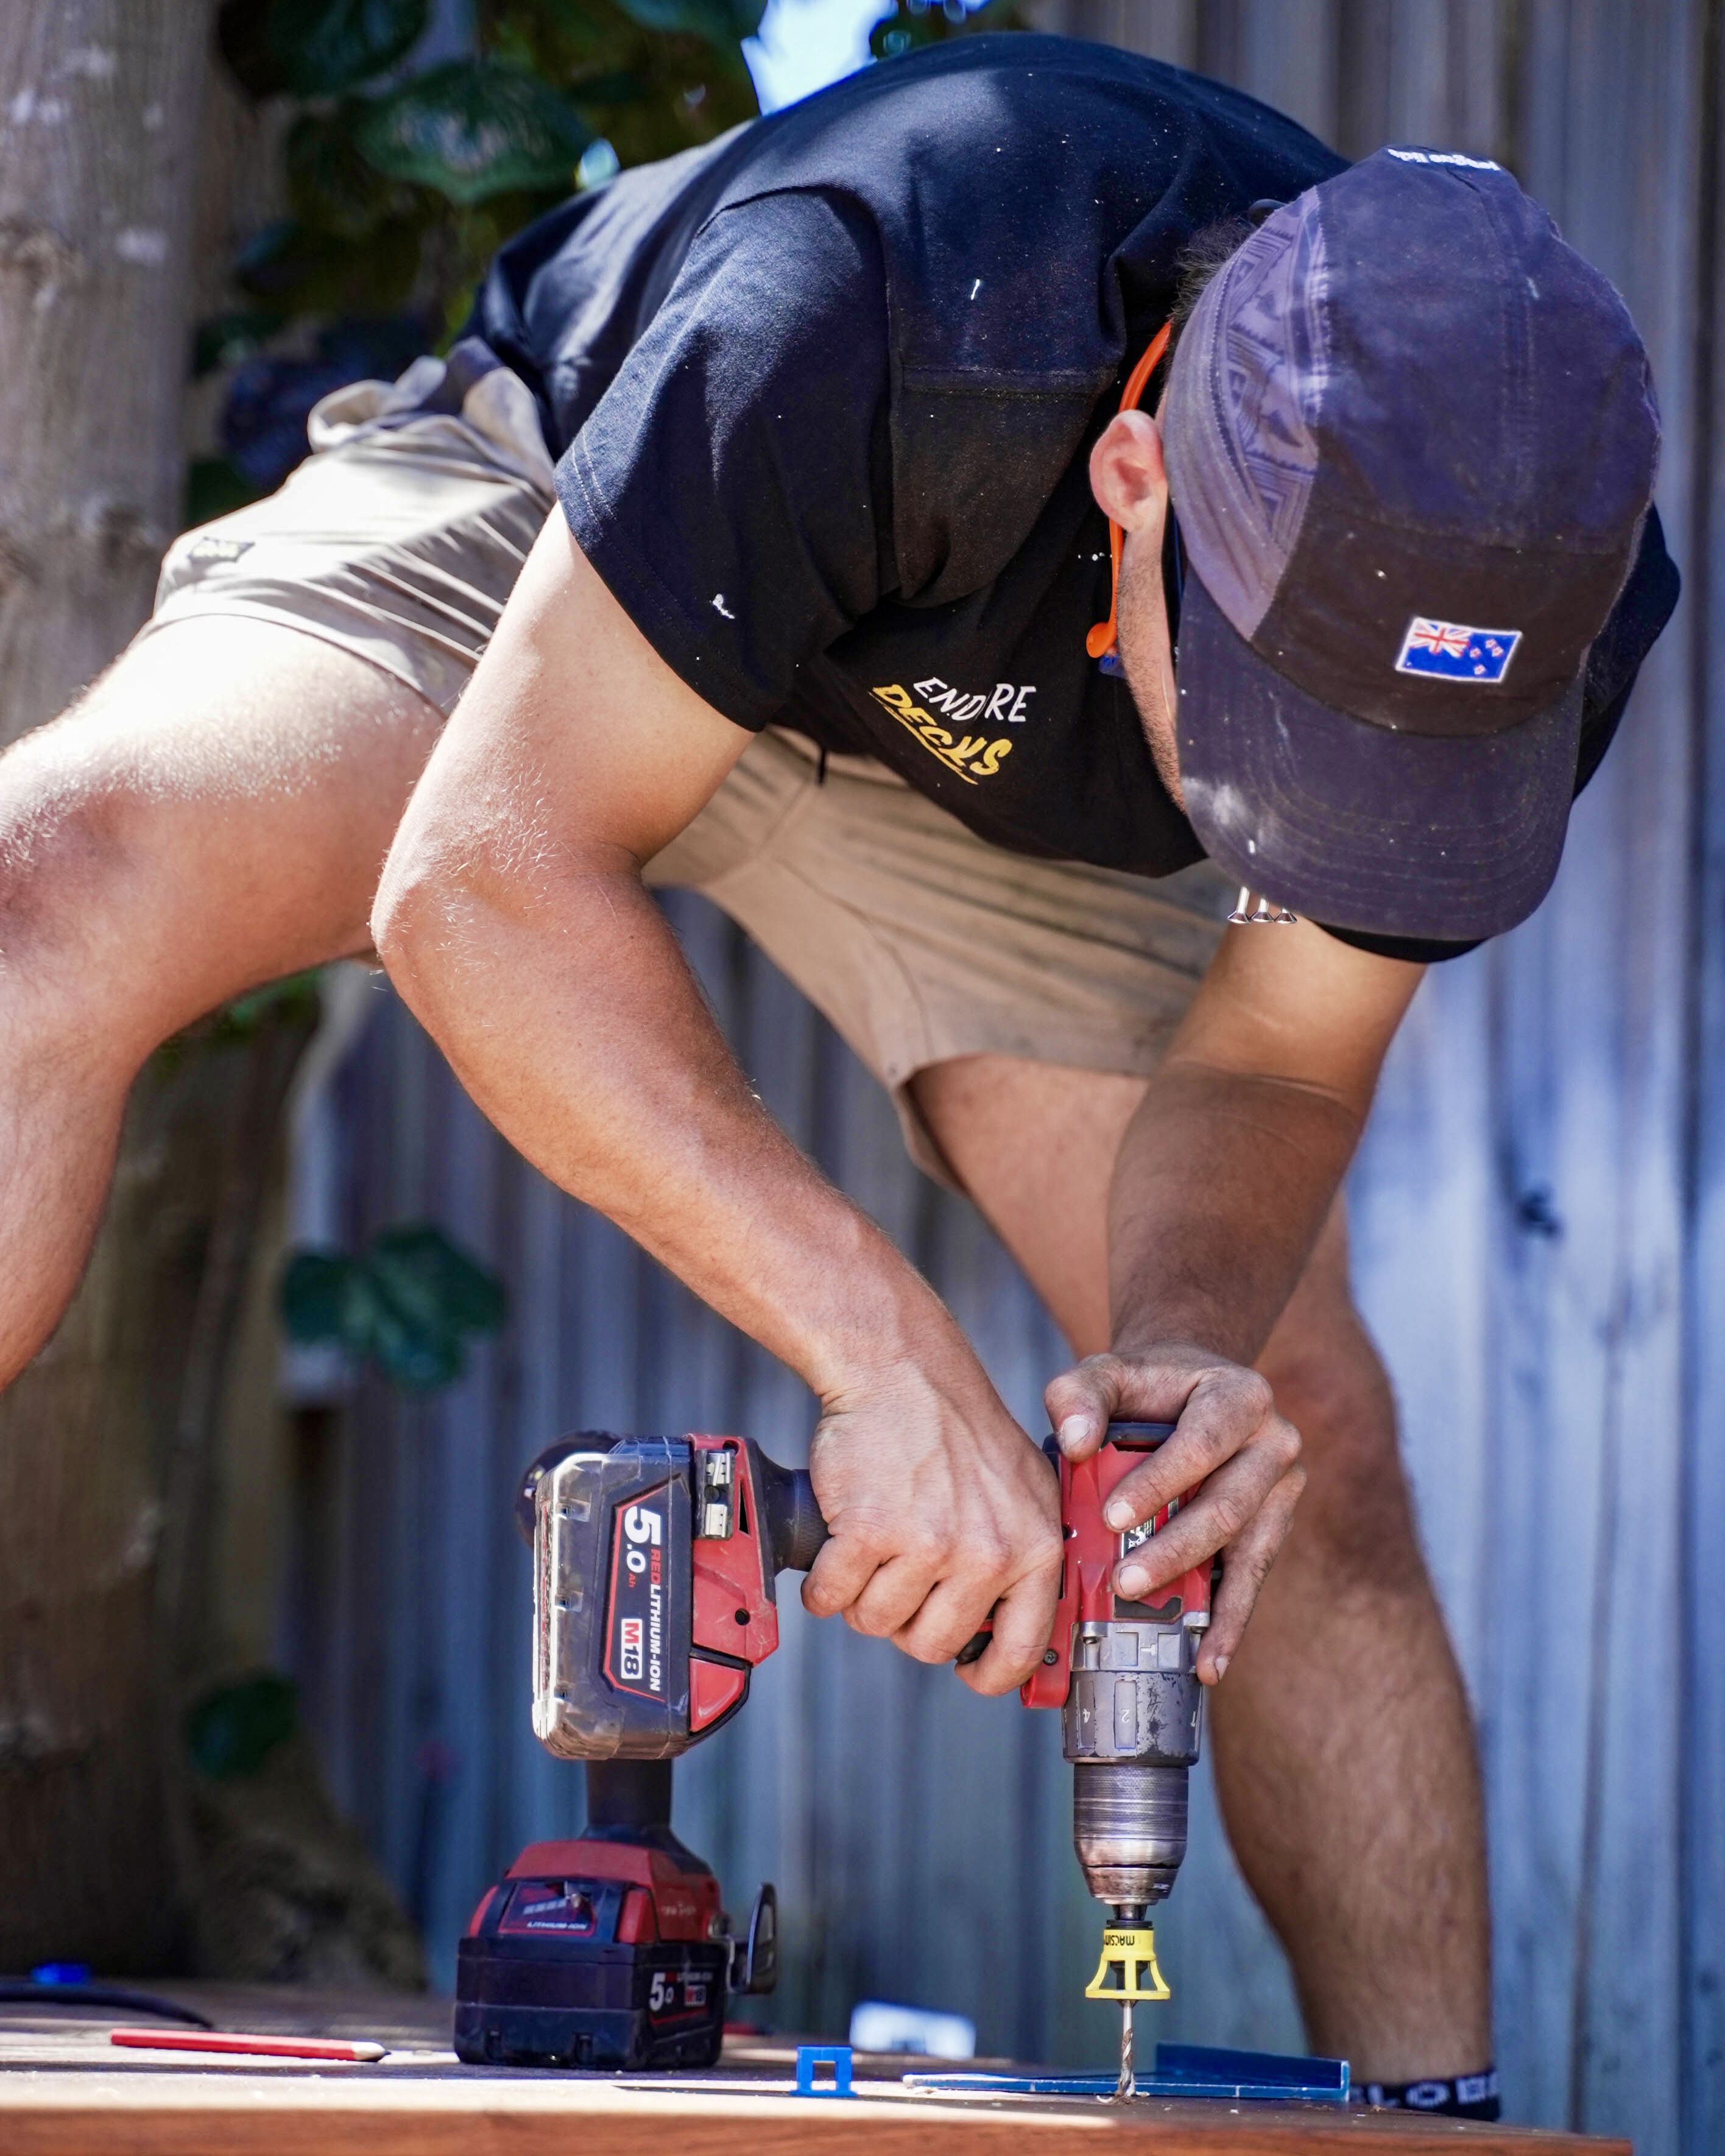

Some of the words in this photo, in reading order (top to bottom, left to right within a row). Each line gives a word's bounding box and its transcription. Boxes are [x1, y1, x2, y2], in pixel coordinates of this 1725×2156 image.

[872, 683, 1013, 775] DECKS
[913, 676, 1037, 723] ENDRE
[624, 1506, 661, 1574] 5.0
[624, 1622, 640, 1675] M18
